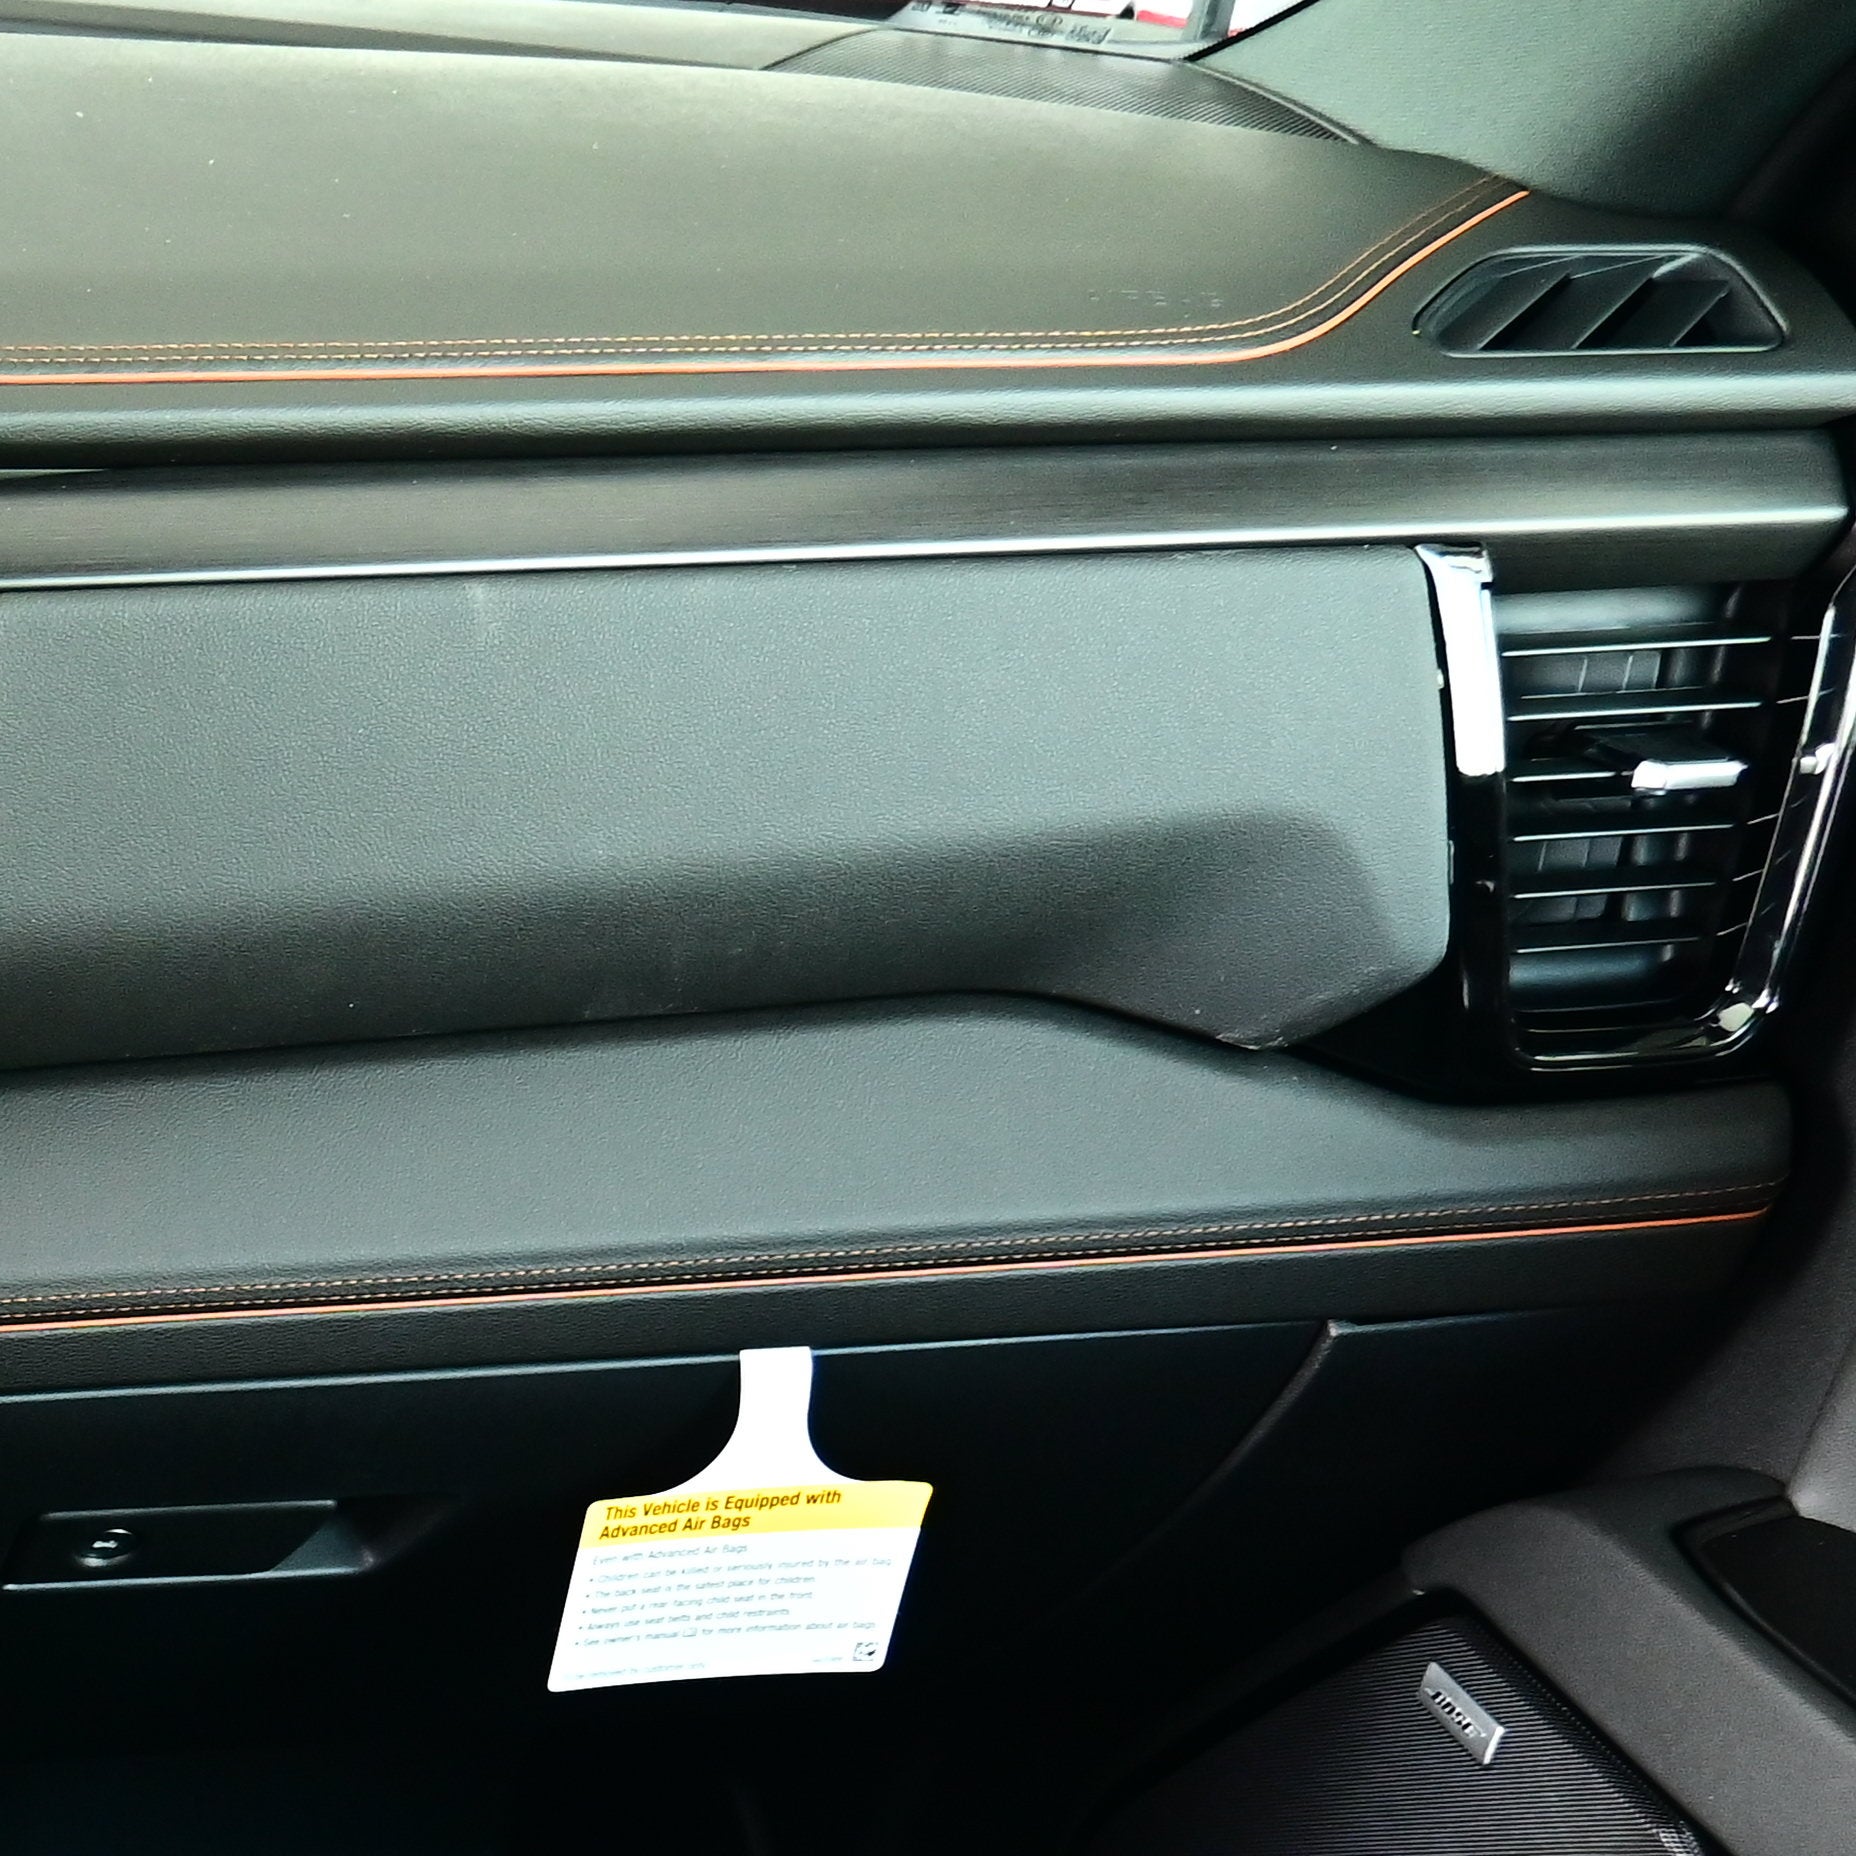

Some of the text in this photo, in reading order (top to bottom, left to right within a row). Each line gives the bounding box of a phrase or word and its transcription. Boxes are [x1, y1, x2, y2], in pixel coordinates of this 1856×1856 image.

[605, 1490, 841, 1521] This Vehicle is Equipped with
[599, 1515, 751, 1540] Advanced Air Bags
